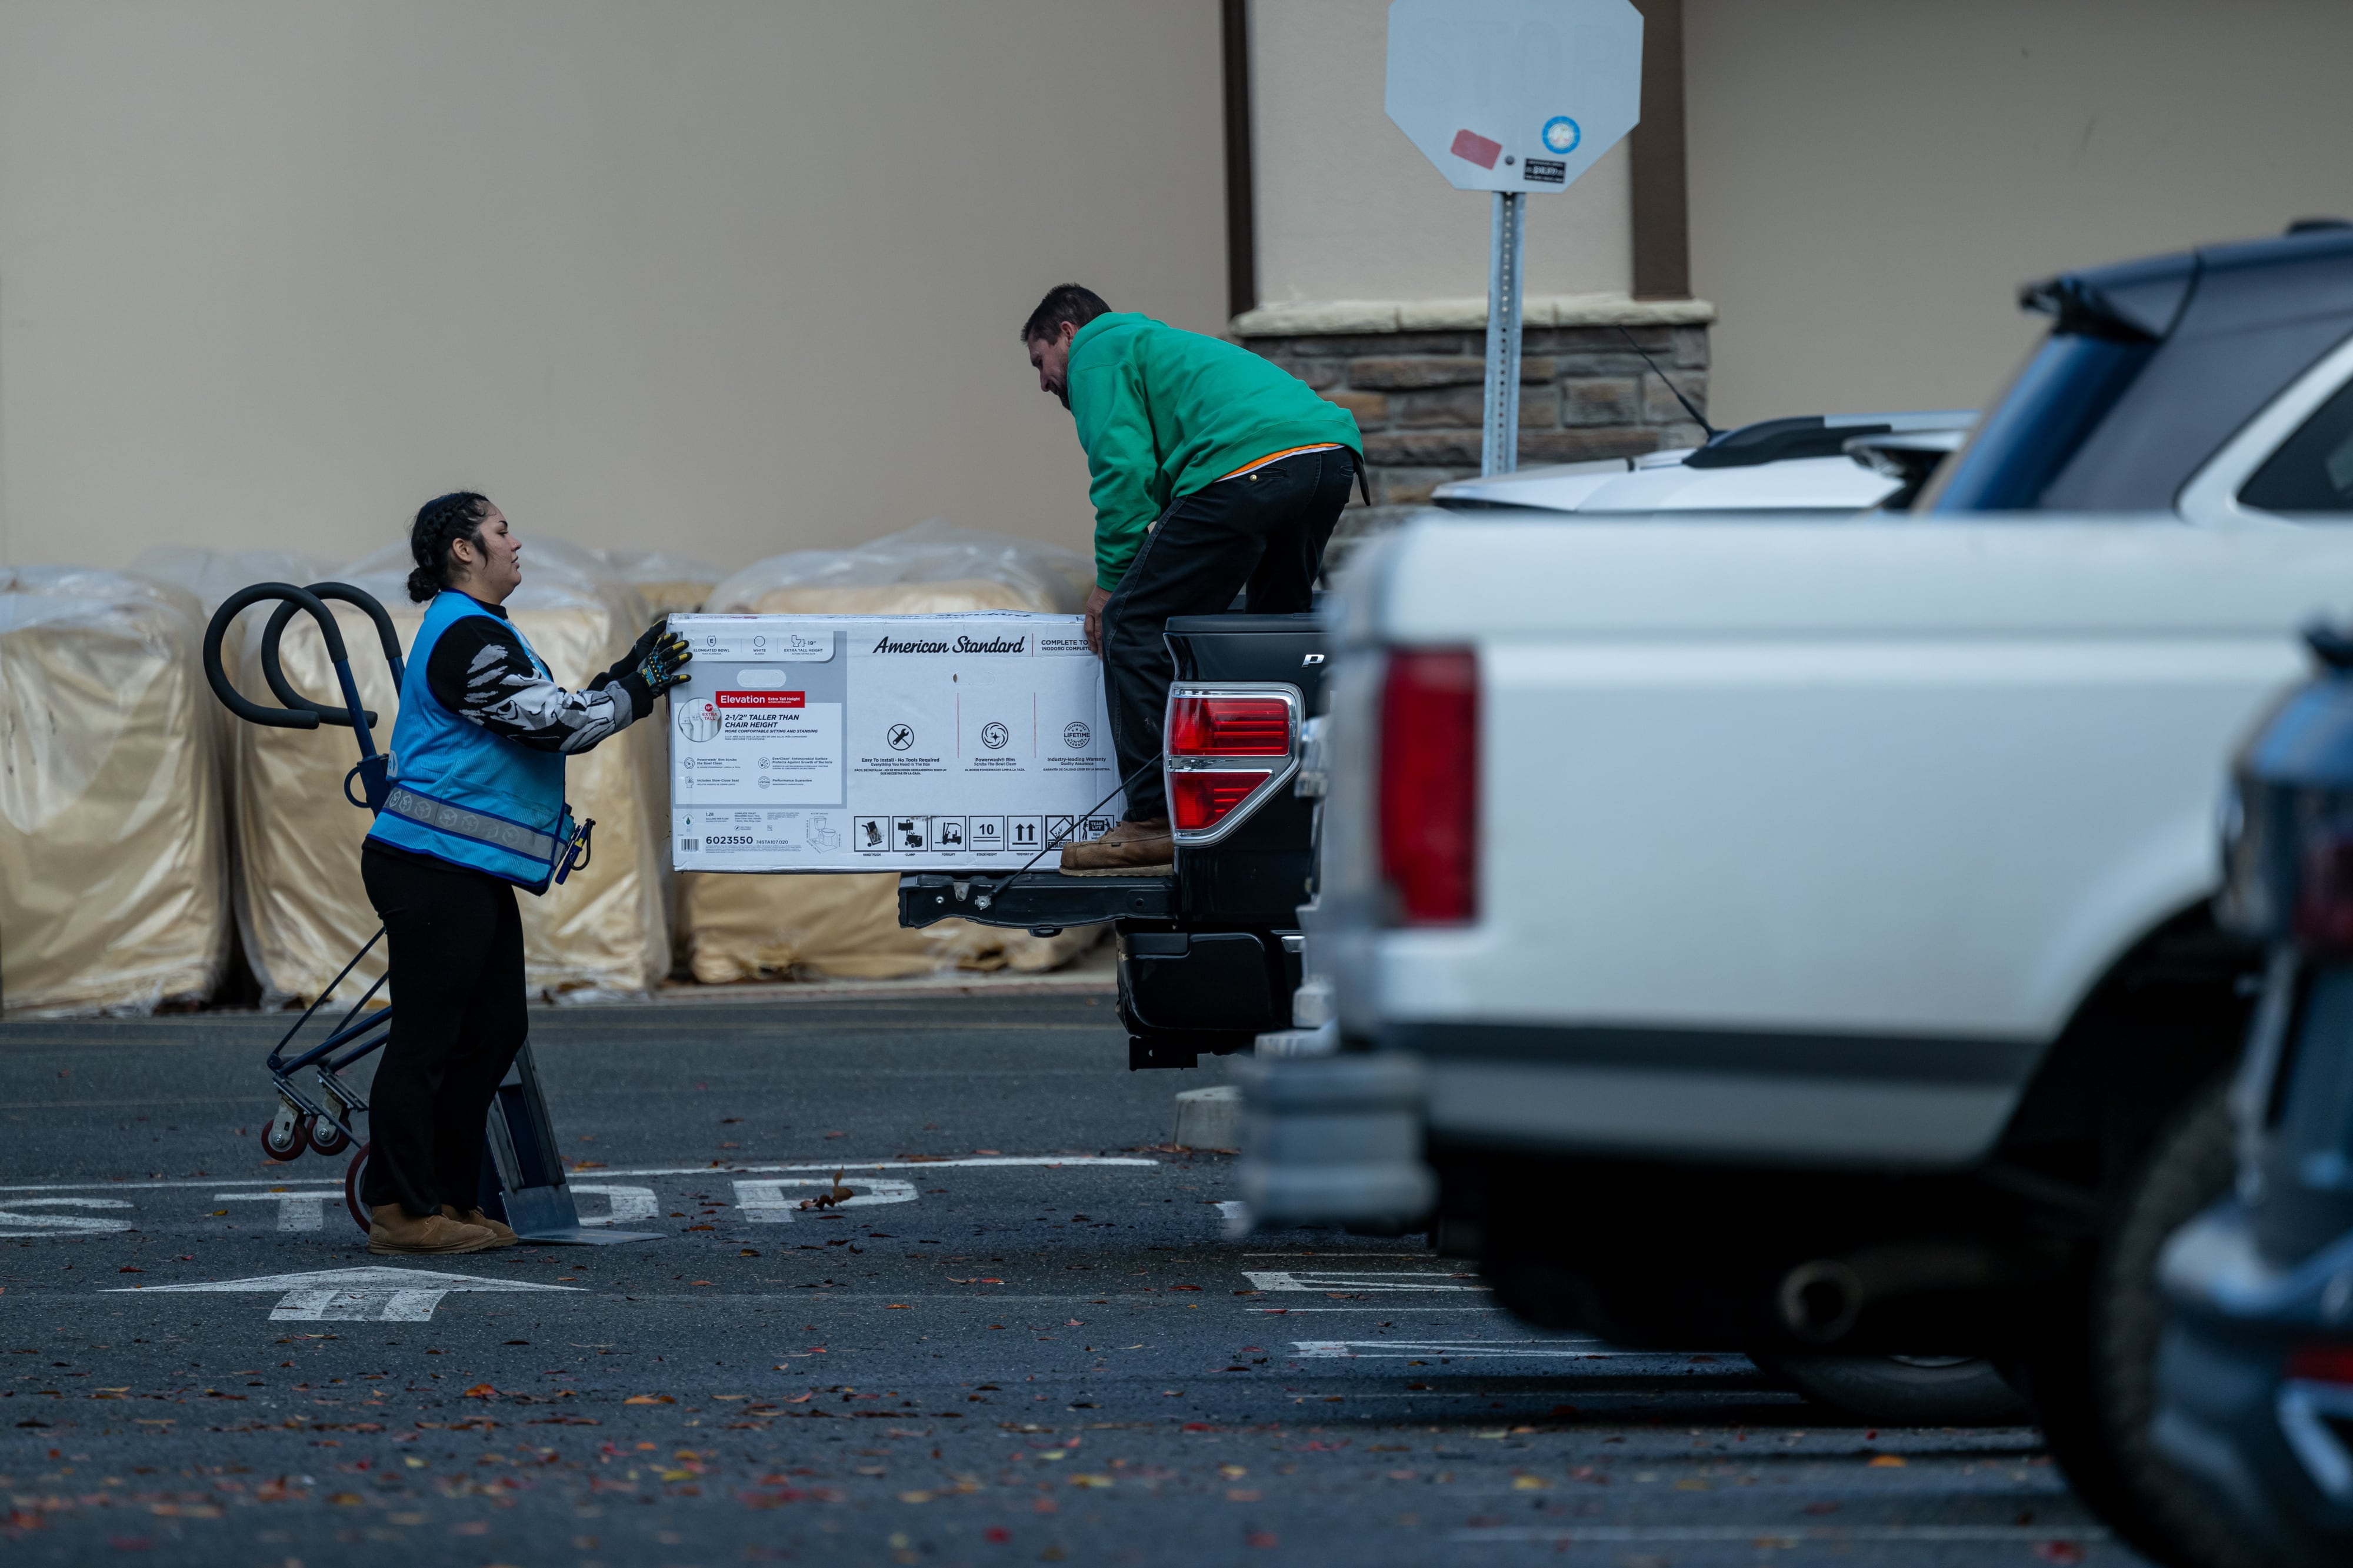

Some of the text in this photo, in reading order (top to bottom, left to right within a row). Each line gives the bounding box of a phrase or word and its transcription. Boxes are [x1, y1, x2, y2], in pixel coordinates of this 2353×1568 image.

[873, 636, 1025, 653] American Standard
[721, 695, 765, 703] Elevation
[1067, 738, 1086, 746] WARRANTY
[979, 824, 994, 835] 10
